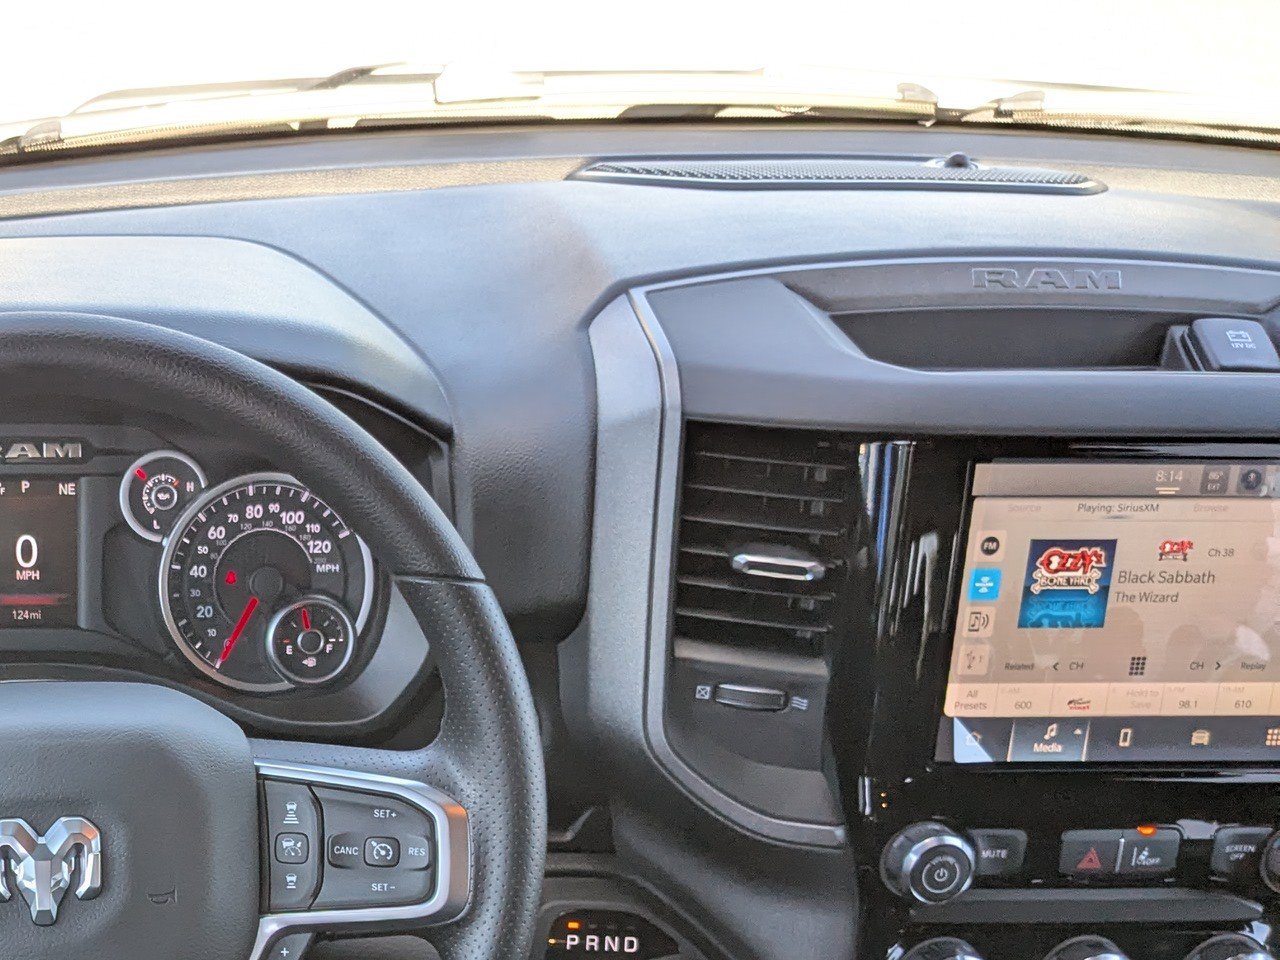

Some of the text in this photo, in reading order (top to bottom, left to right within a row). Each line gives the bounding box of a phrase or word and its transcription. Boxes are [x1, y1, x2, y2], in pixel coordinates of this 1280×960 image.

[971, 267, 1121, 289] RAM
[1155, 470, 1183, 482] 8:14
[21, 481, 31, 493] P
[58, 483, 76, 495] NE
[186, 481, 195, 492] H
[245, 504, 263, 519] 80
[268, 502, 280, 514] 90
[1077, 503, 1160, 514] Playing: SiriusXM
[227, 513, 239, 523] 70
[280, 511, 305, 525] 100
[208, 526, 226, 540] 60
[305, 523, 320, 533] 110
[197, 546, 209, 554] 50
[307, 540, 332, 554] 120
[983, 541, 997, 550] FM
[15, 535, 38, 568] 0
[1207, 548, 1235, 558] Ch 38
[189, 565, 207, 578] 40
[316, 563, 340, 573] MPH
[16, 570, 40, 580] MPH
[1118, 570, 1215, 584] Black Sabbath
[189, 589, 201, 597] 30
[1114, 591, 1179, 603] The Wizard
[196, 606, 213, 618] 20
[207, 629, 217, 637] 10
[286, 644, 293, 654] E
[326, 644, 333, 654] F
[1069, 662, 1084, 670] CH
[1189, 662, 1204, 670] CH
[1241, 662, 1266, 671] Replay
[954, 702, 987, 710] Presets
[1014, 701, 1032, 709] 600
[1178, 700, 1198, 709] 98.1
[1234, 700, 1252, 709] 610
[1033, 743, 1062, 753] Media
[334, 846, 359, 855] CANC
[408, 847, 426, 856] RES
